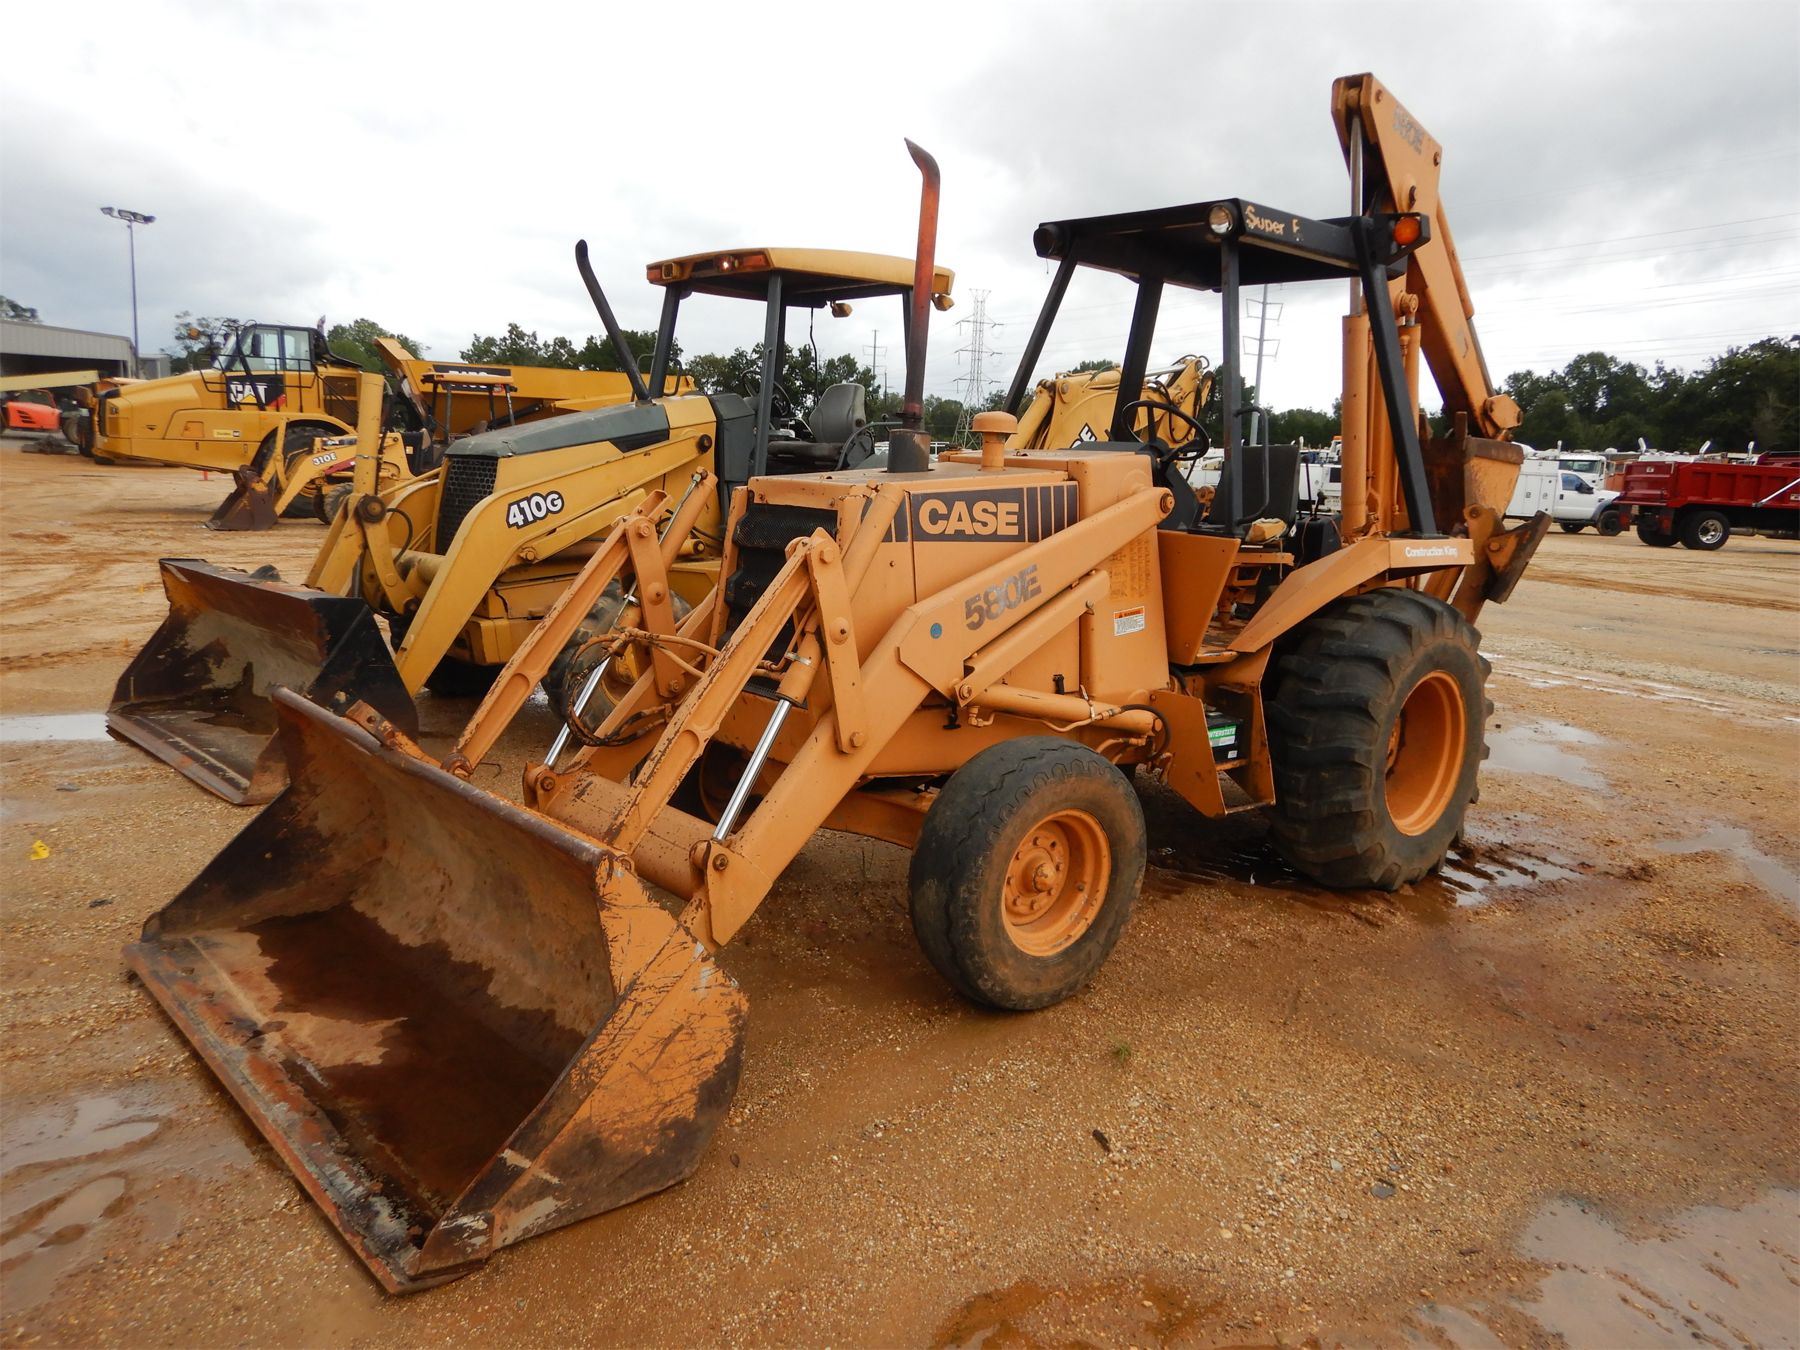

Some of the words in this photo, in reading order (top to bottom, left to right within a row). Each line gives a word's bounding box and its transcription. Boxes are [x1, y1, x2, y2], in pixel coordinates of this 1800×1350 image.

[1245, 205, 1285, 235] Super
[230, 382, 268, 404] CAT
[312, 452, 337, 466] 310E
[507, 491, 564, 529] 410G
[918, 498, 1019, 536] CASE
[964, 563, 1042, 630] 580E
